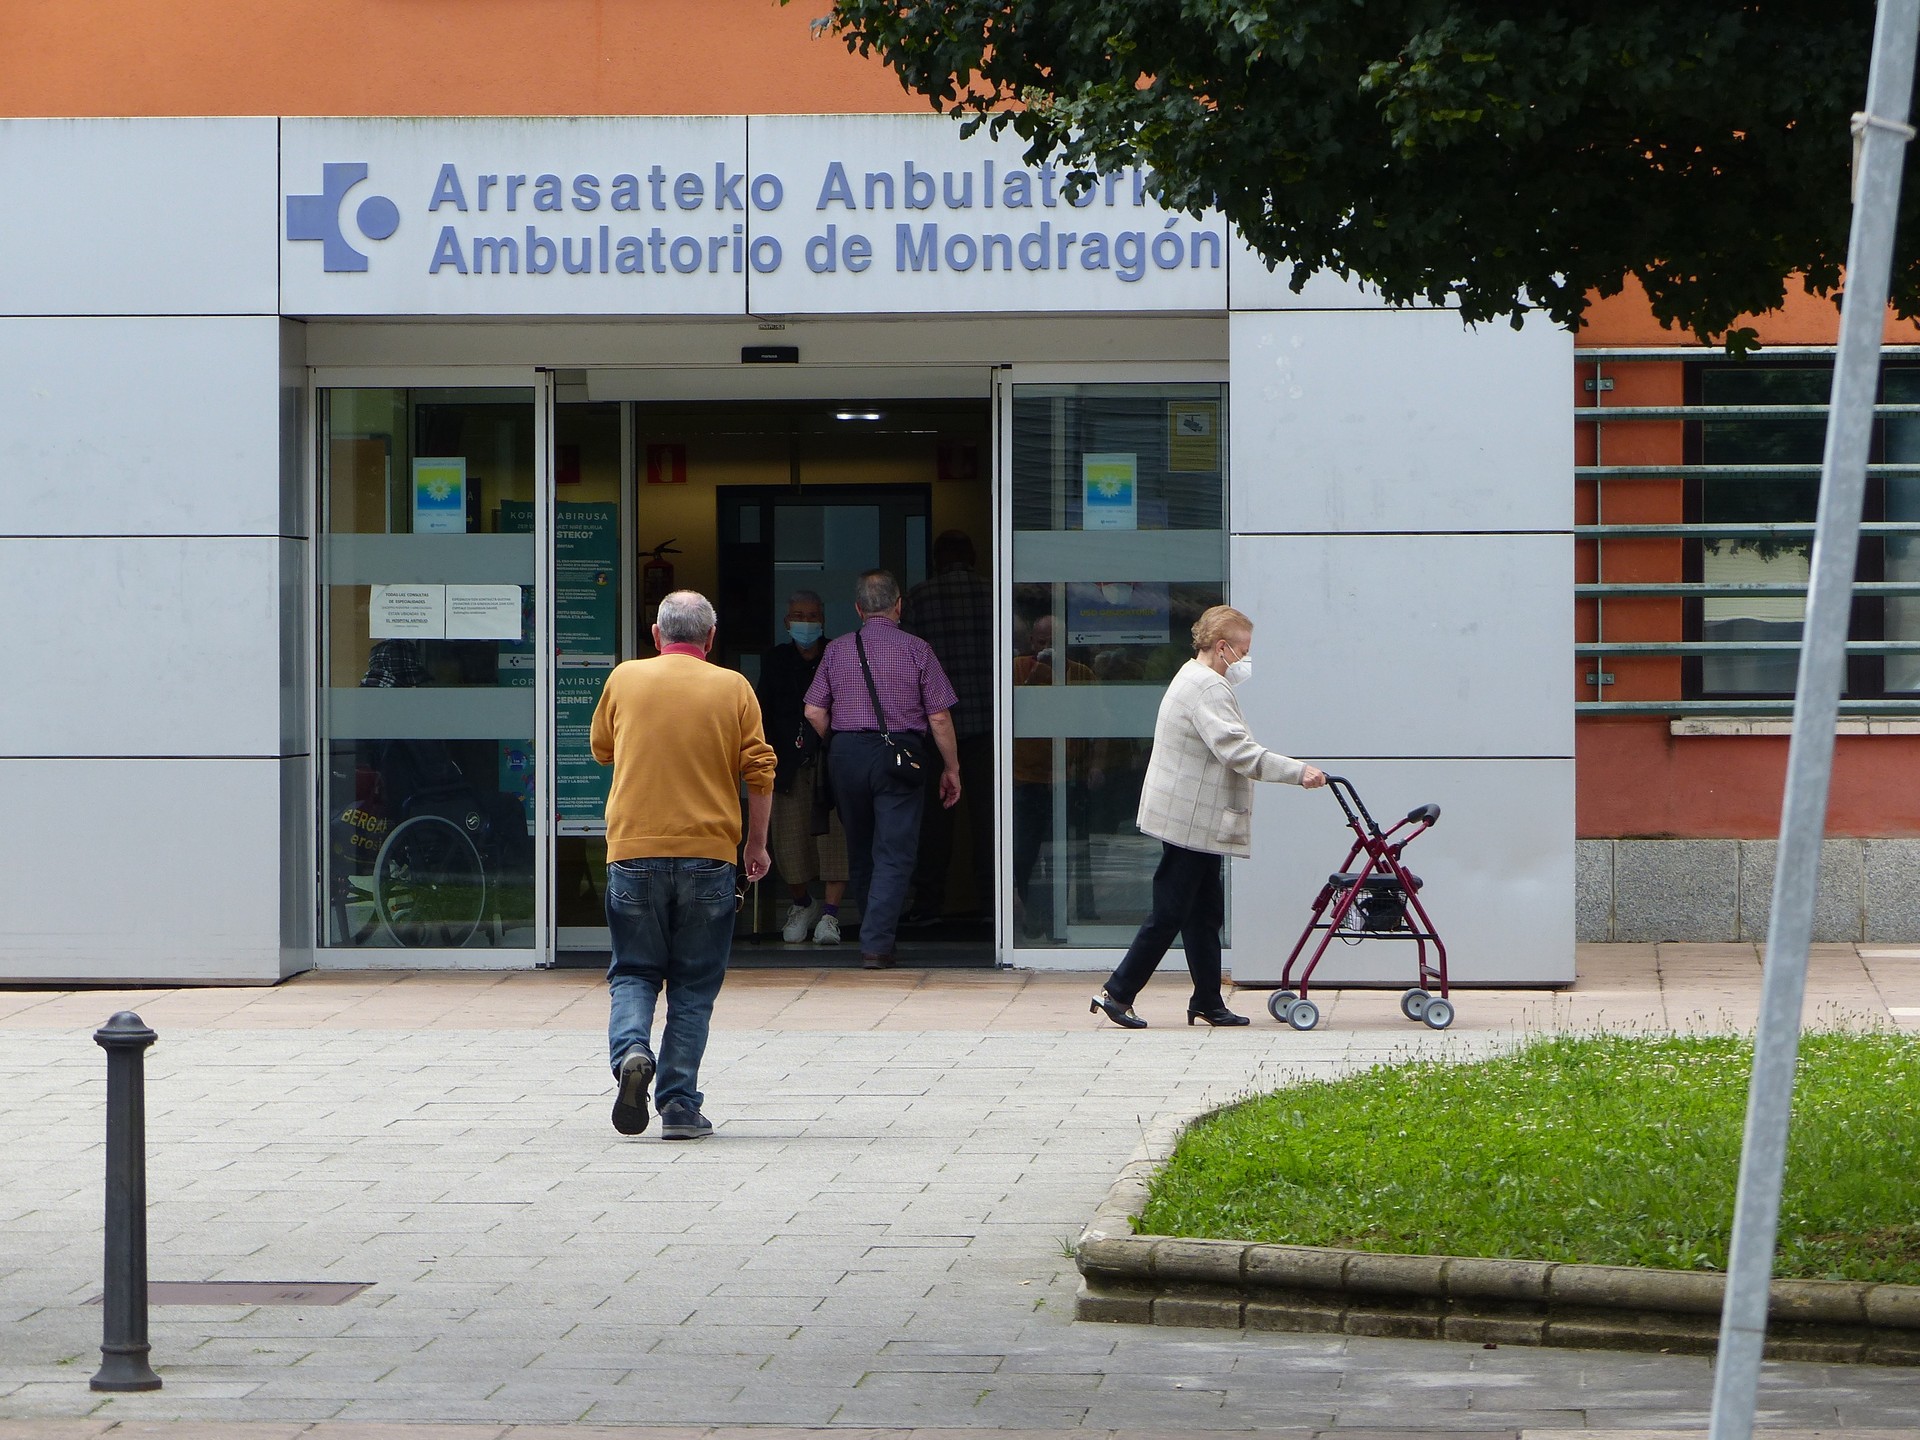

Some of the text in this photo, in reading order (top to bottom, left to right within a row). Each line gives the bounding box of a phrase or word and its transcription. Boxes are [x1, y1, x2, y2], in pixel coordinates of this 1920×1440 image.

[428, 159, 1217, 212] Arrasateko Anbulatori
[428, 217, 1221, 283] Ambulatorio de Mondragón
